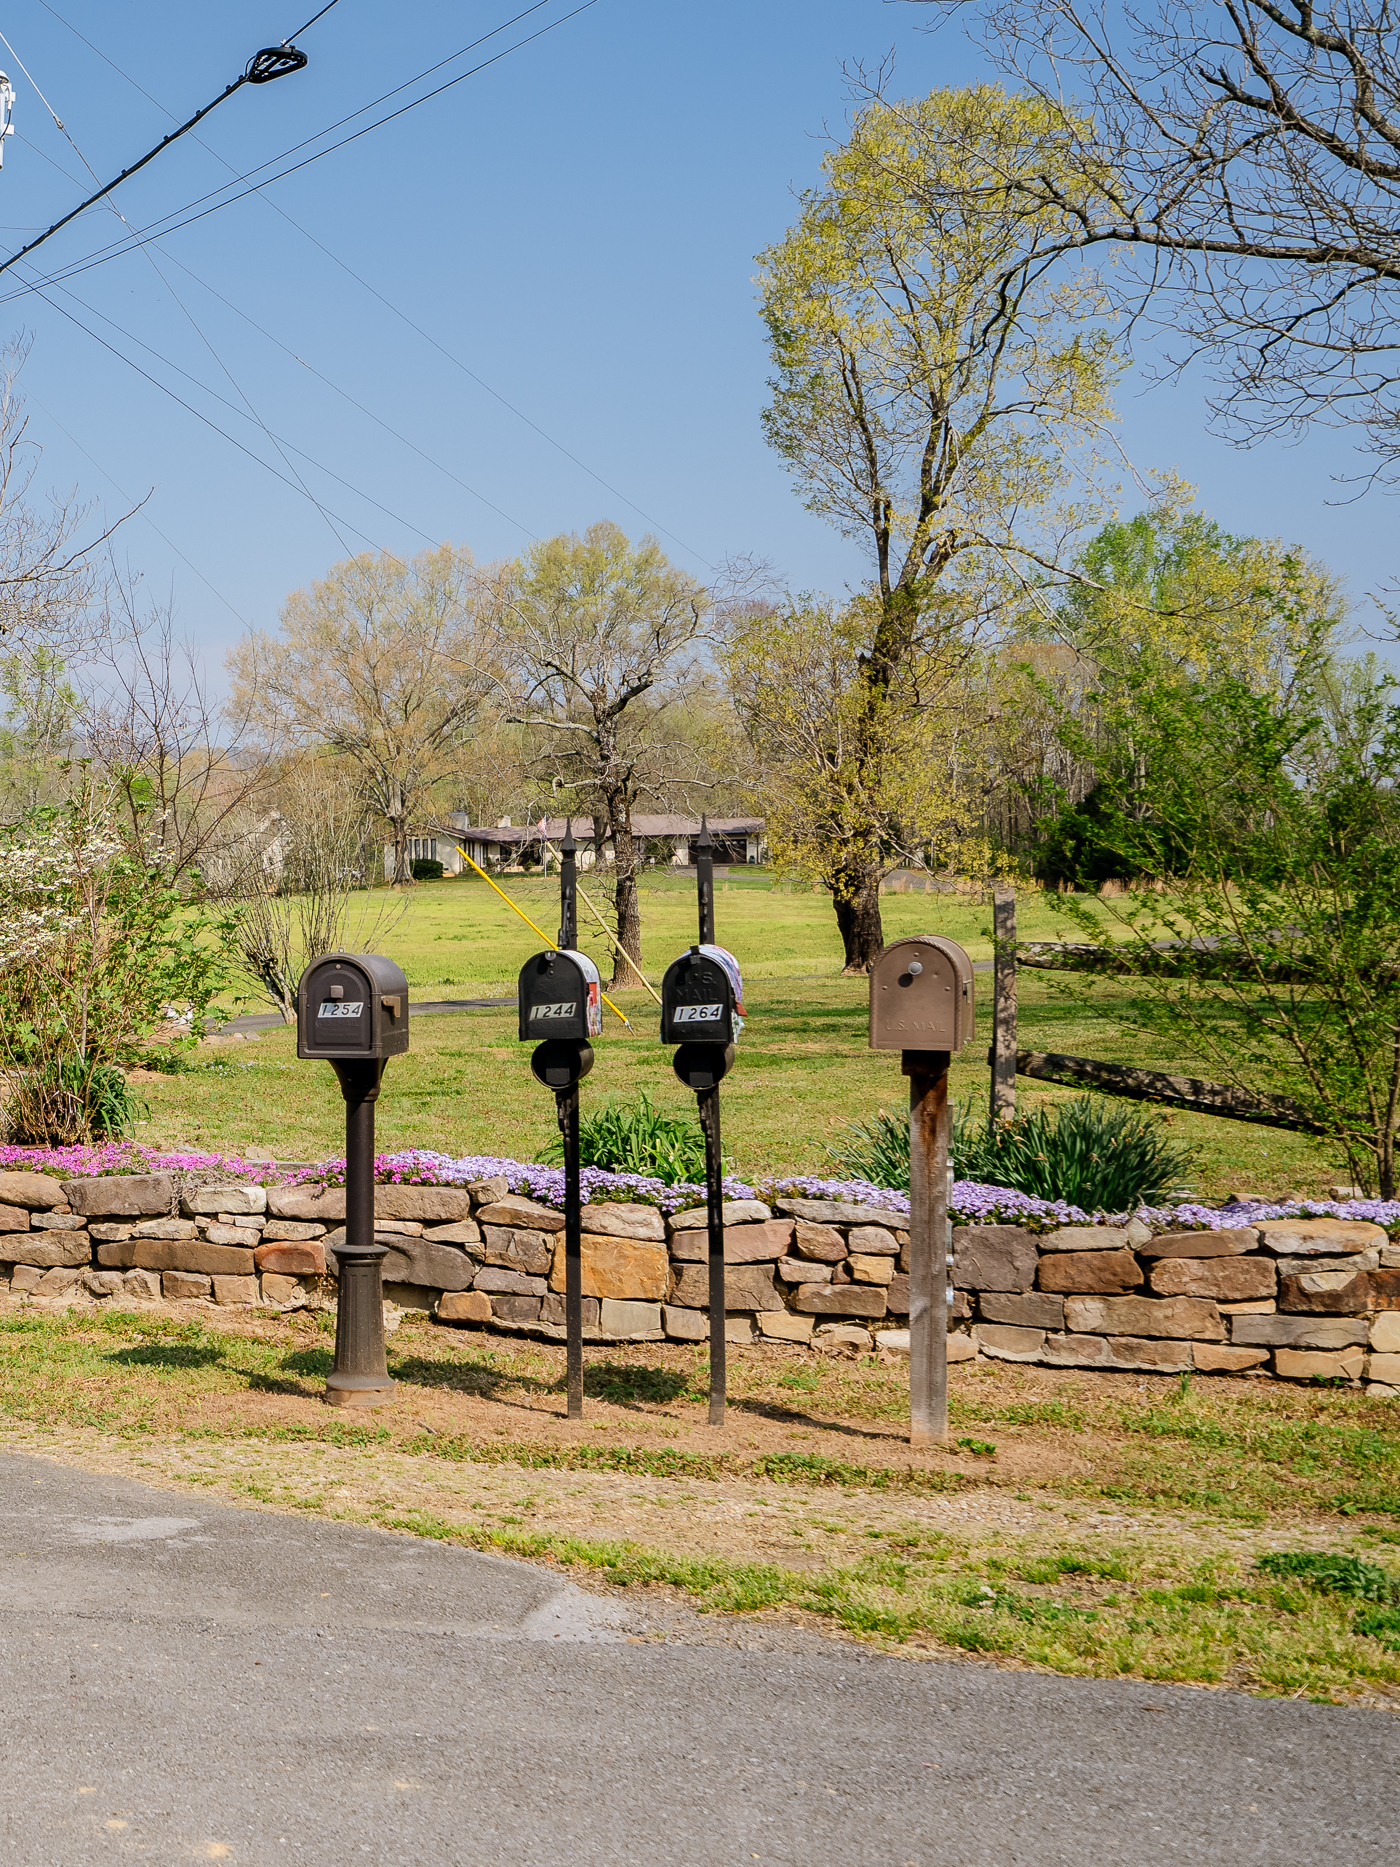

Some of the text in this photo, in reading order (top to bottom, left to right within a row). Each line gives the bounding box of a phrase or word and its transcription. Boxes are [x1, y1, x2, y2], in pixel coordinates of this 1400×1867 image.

[675, 988, 718, 1002] MAIL
[321, 1004, 362, 1016] 1254
[534, 1003, 574, 1019] 1244
[678, 1005, 721, 1021] 1264
[337, 1019, 360, 1027] MAIL
[886, 1020, 946, 1033] U.S. MAIL
